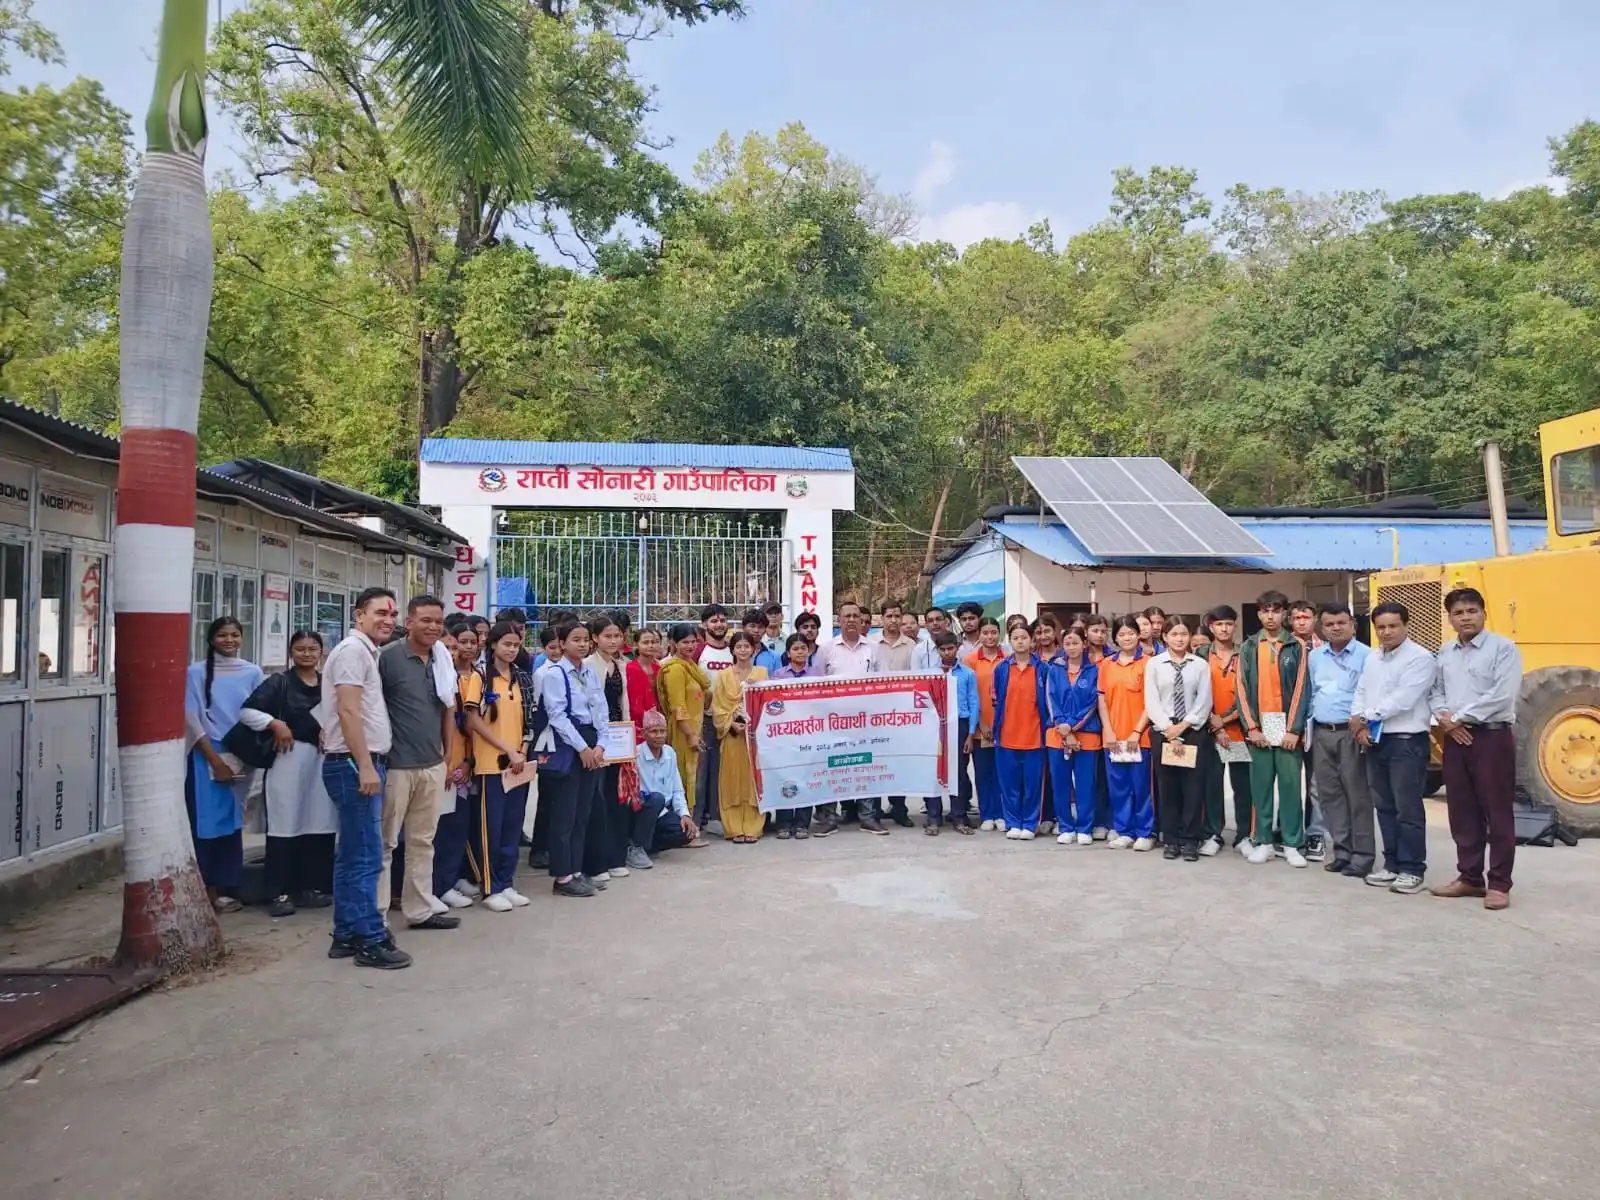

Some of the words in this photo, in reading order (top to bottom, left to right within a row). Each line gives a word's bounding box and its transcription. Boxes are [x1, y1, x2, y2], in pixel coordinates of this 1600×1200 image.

[516, 464, 570, 489] राप्ती
[577, 464, 656, 490] सोनारी
[663, 467, 777, 492] गाउँपालिका
[870, 709, 922, 727] कार्यक्रम
